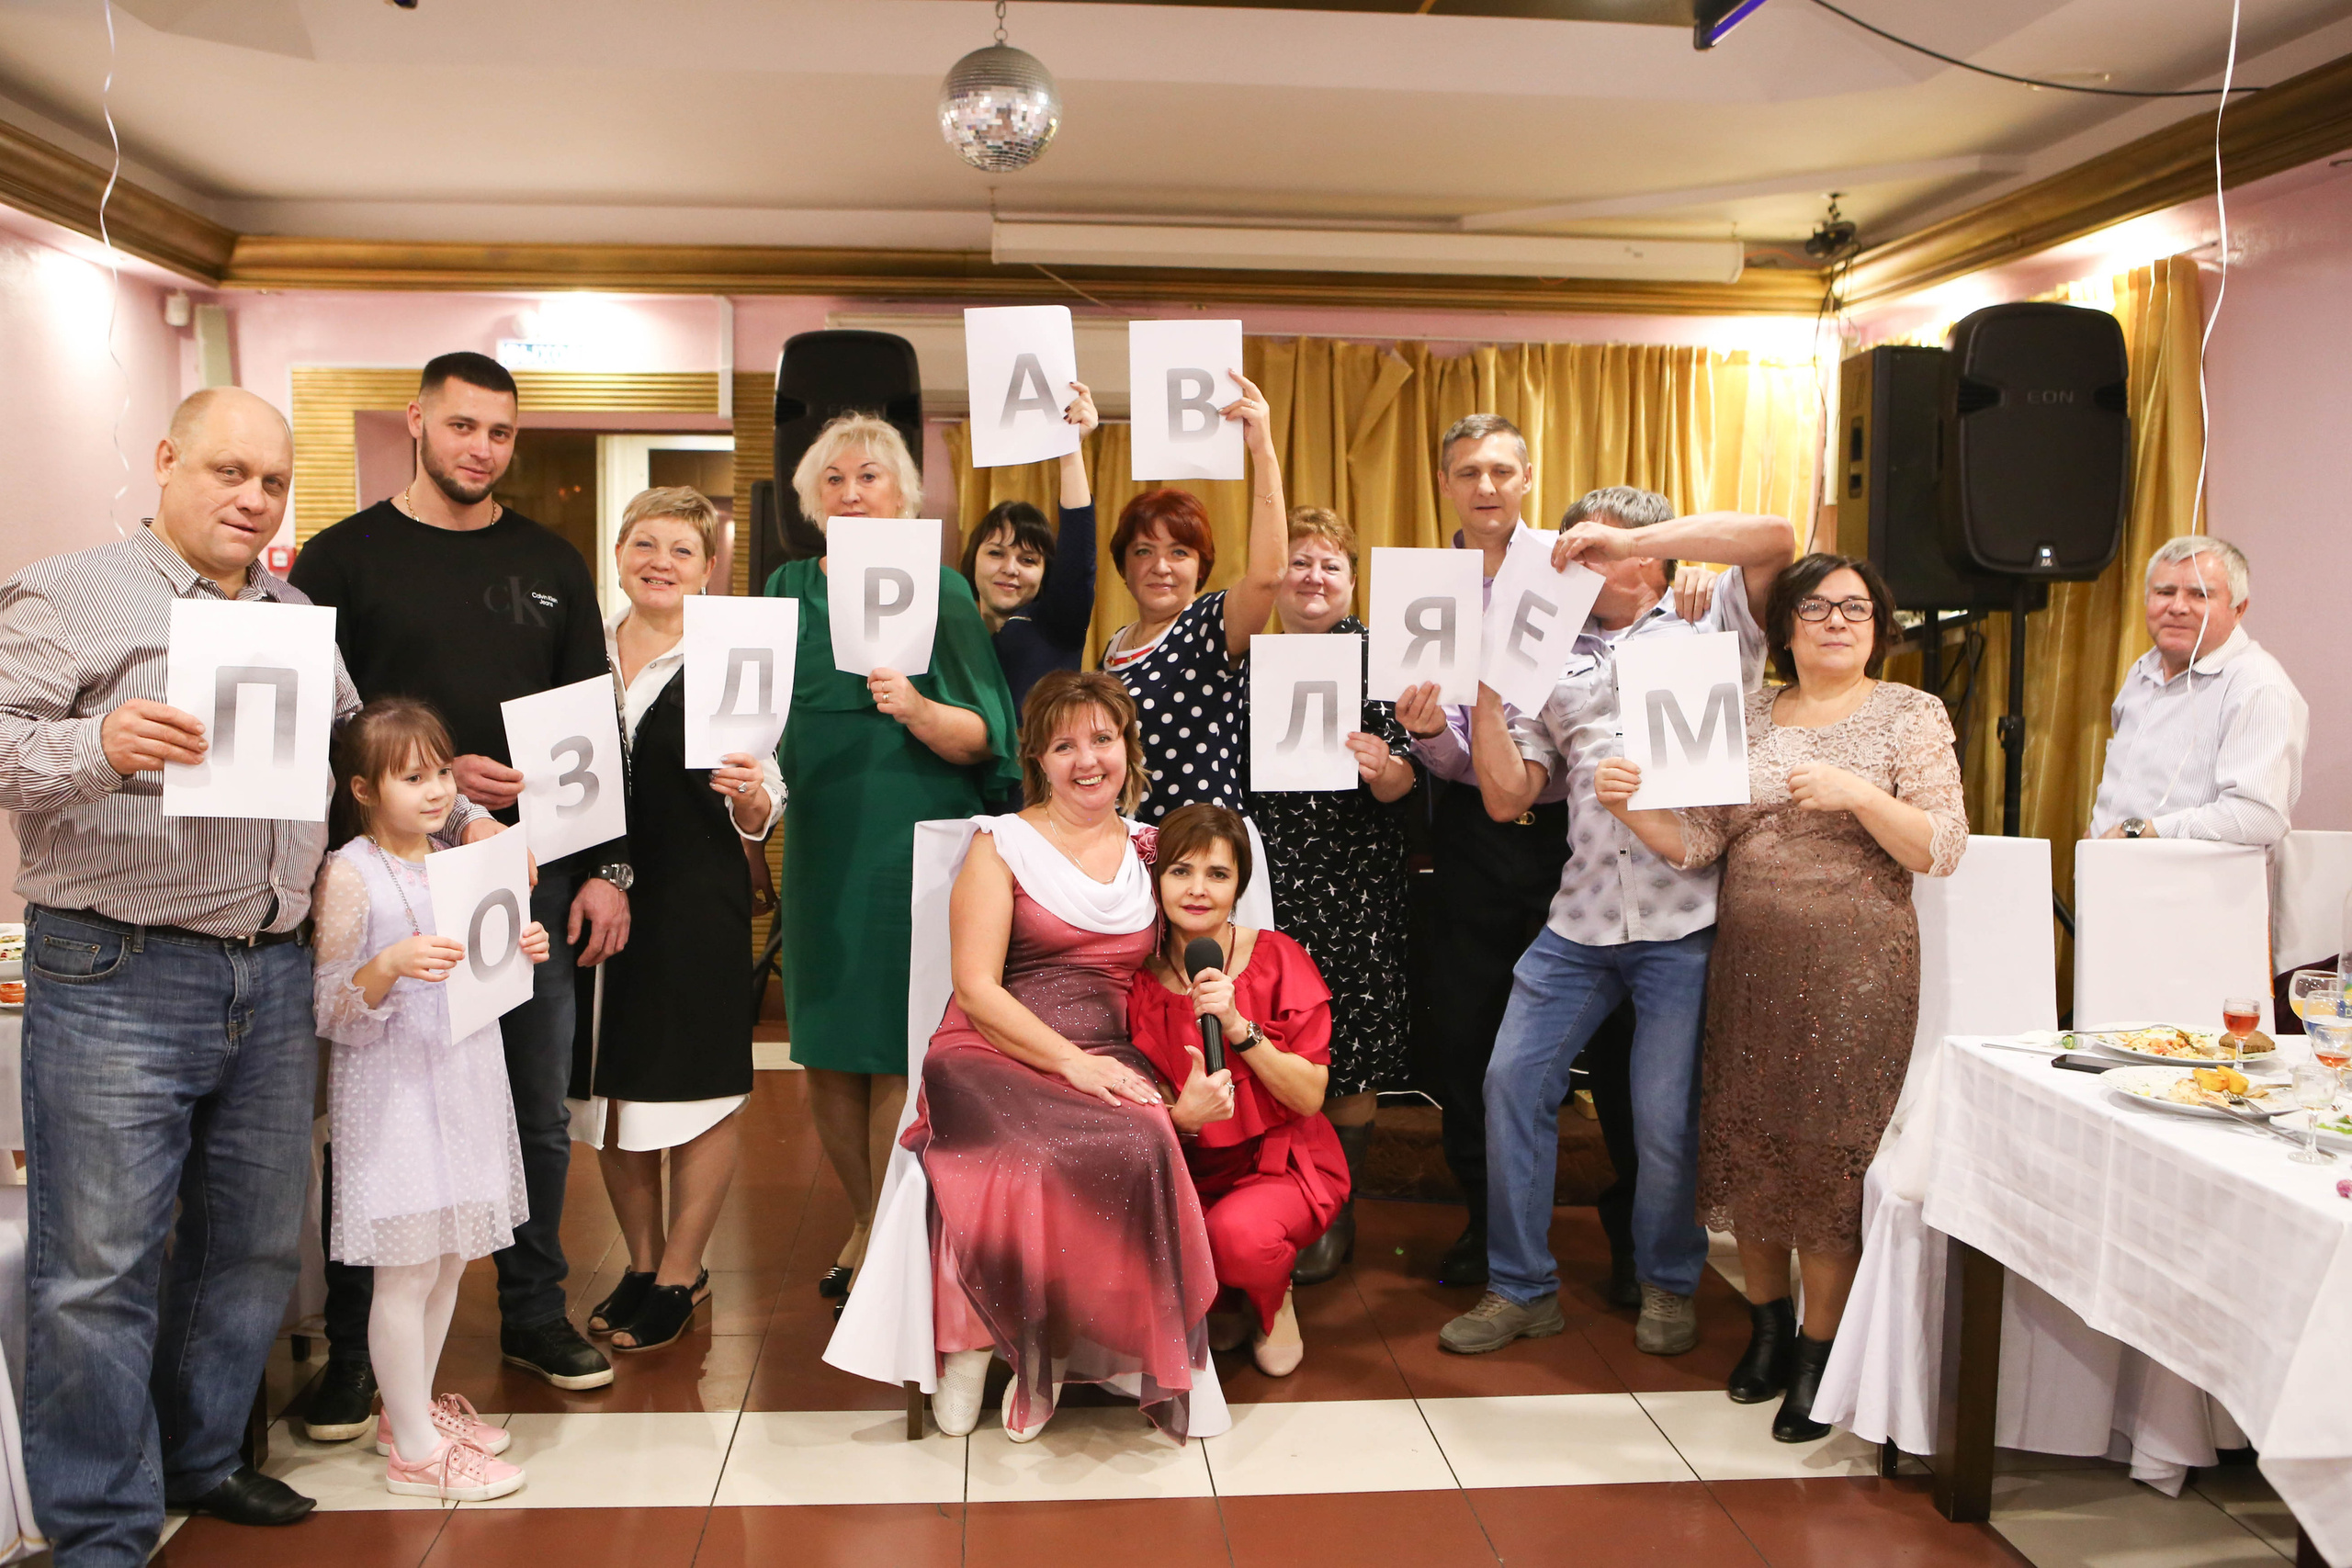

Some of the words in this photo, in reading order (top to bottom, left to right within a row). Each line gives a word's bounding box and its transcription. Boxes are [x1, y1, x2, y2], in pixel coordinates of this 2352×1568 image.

[999, 353, 1062, 428] А
[1166, 367, 1220, 441] В
[2027, 389, 2074, 404] EON
[864, 567, 915, 642] Р
[1401, 596, 1456, 669] Я
[1506, 589, 1558, 669] Е
[211, 666, 299, 769] П
[709, 648, 777, 728] Д
[1276, 680, 1339, 752] Л
[1645, 682, 1743, 769] М
[468, 887, 521, 983] О
